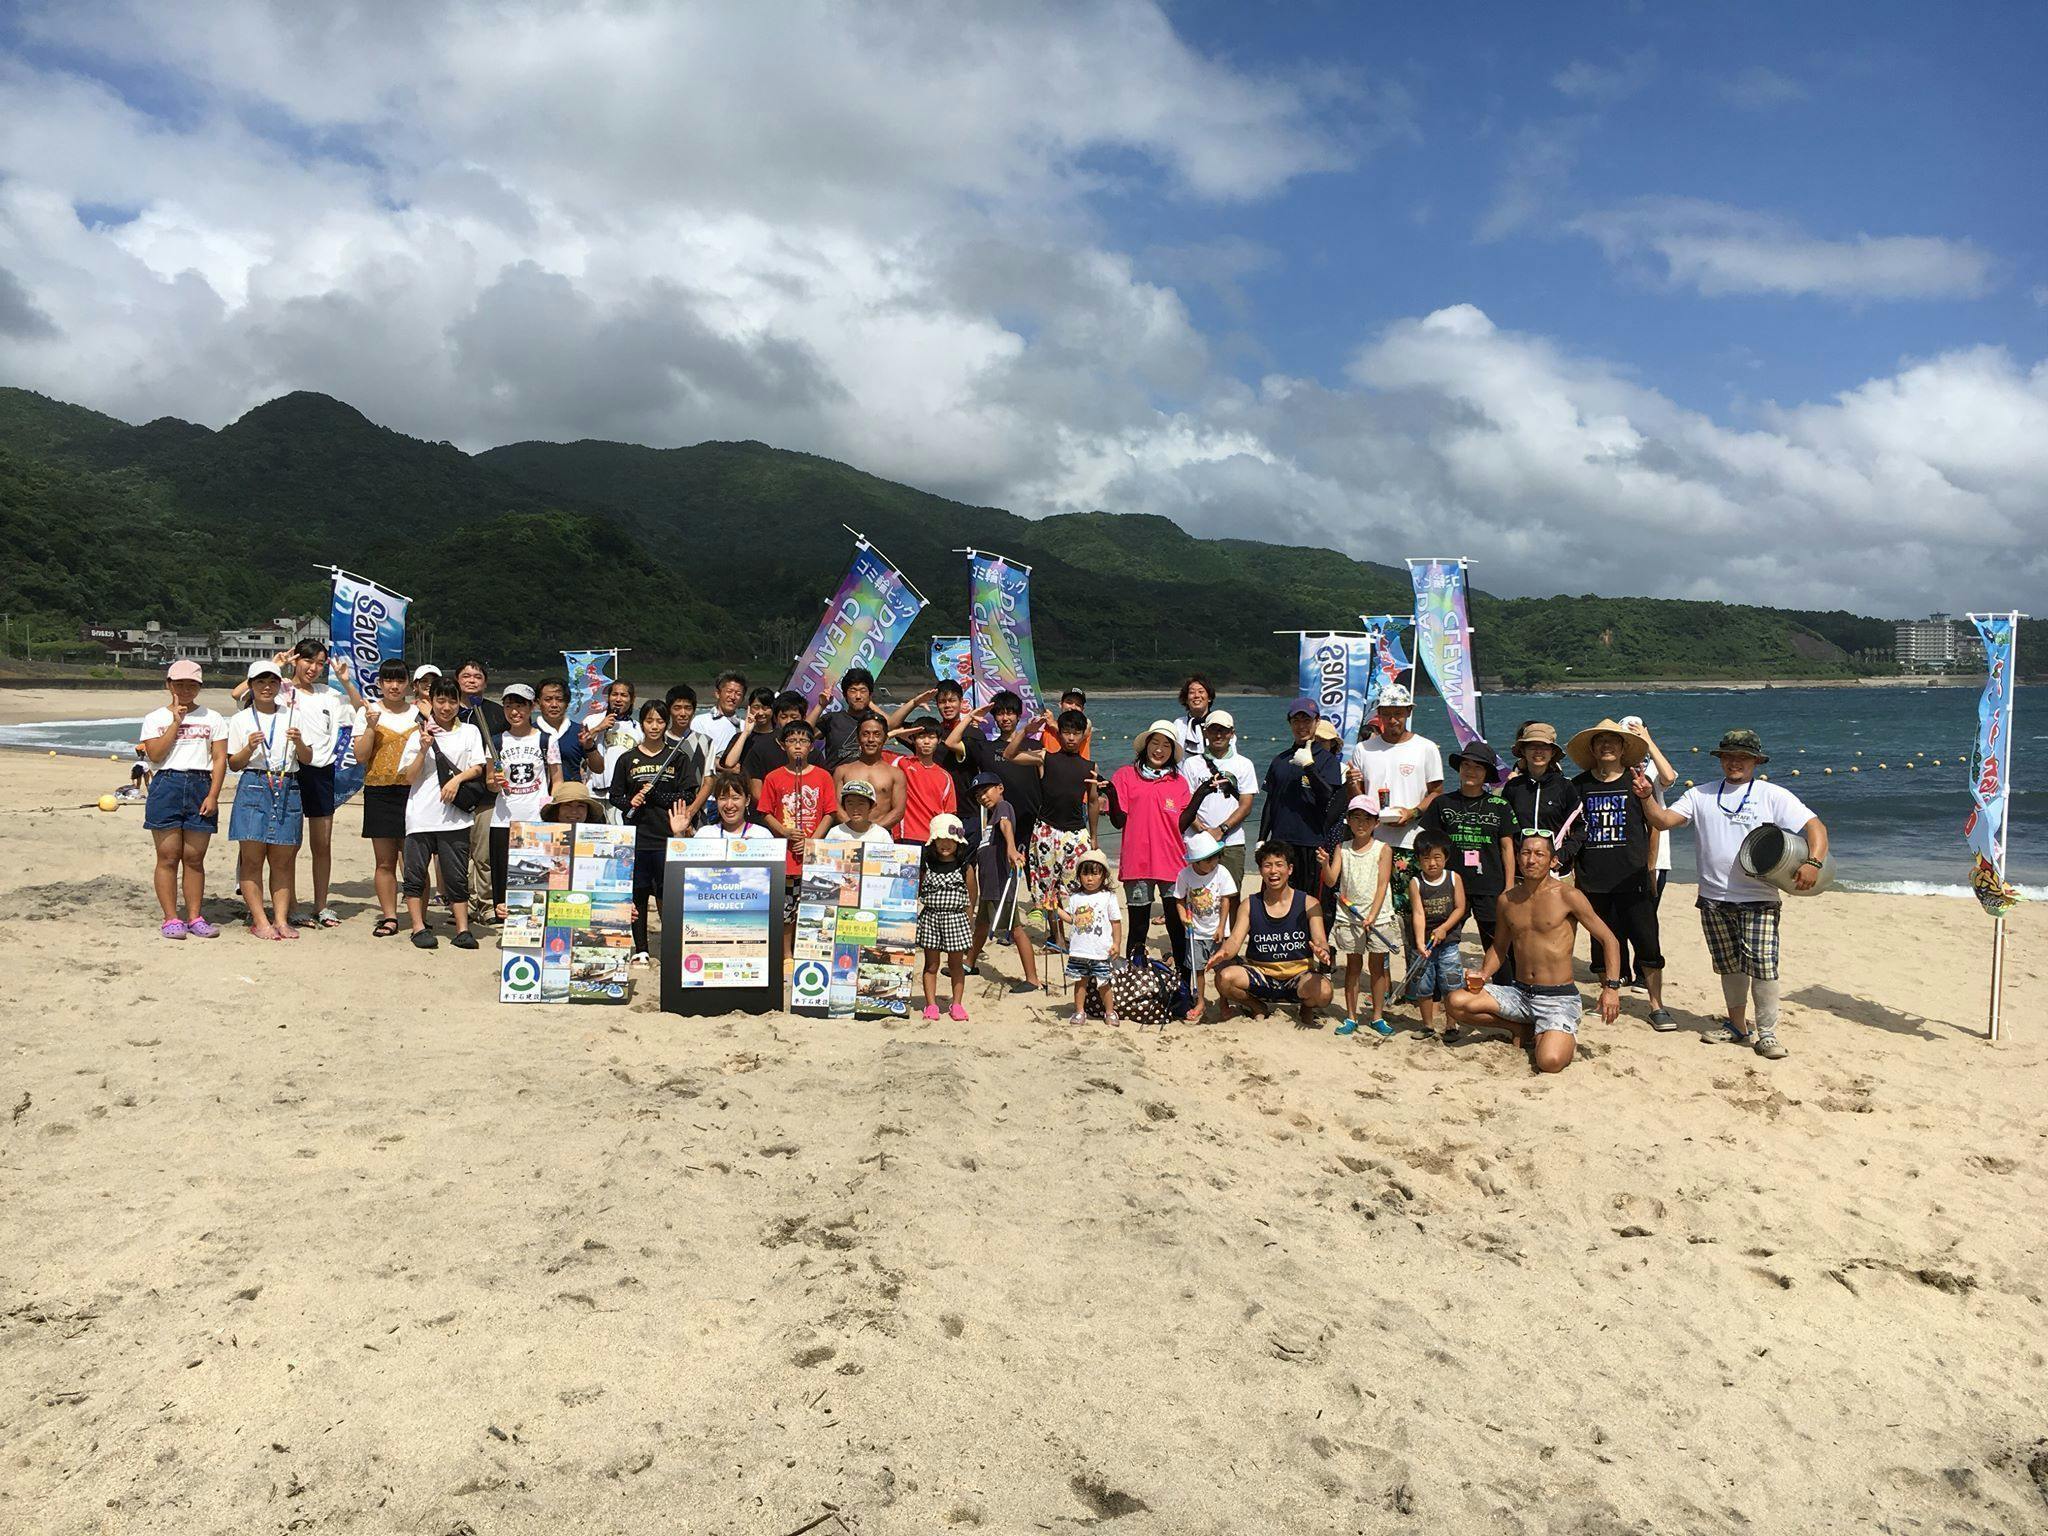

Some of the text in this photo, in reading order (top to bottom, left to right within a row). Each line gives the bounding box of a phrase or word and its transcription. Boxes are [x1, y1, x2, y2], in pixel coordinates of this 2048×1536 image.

[972, 564, 1027, 594] ゴミ輪ピック
[856, 559, 916, 618] ゴミ輪ピック
[353, 590, 389, 664] Save
[808, 597, 861, 677] CLEAN
[973, 602, 1002, 681] CLEAN
[500, 746, 521, 761] WEET
[1586, 795, 1628, 811] GHOST
[1601, 811, 1627, 826] THE
[1587, 827, 1627, 842] SHELL
[711, 883, 743, 891] DAGURI
[697, 892, 758, 901] BEACH CLEAN
[708, 902, 745, 910] PROJECT
[1253, 931, 1306, 943] CHARI & CO
[1280, 941, 1306, 951] YORK
[1272, 952, 1288, 960] CITY
